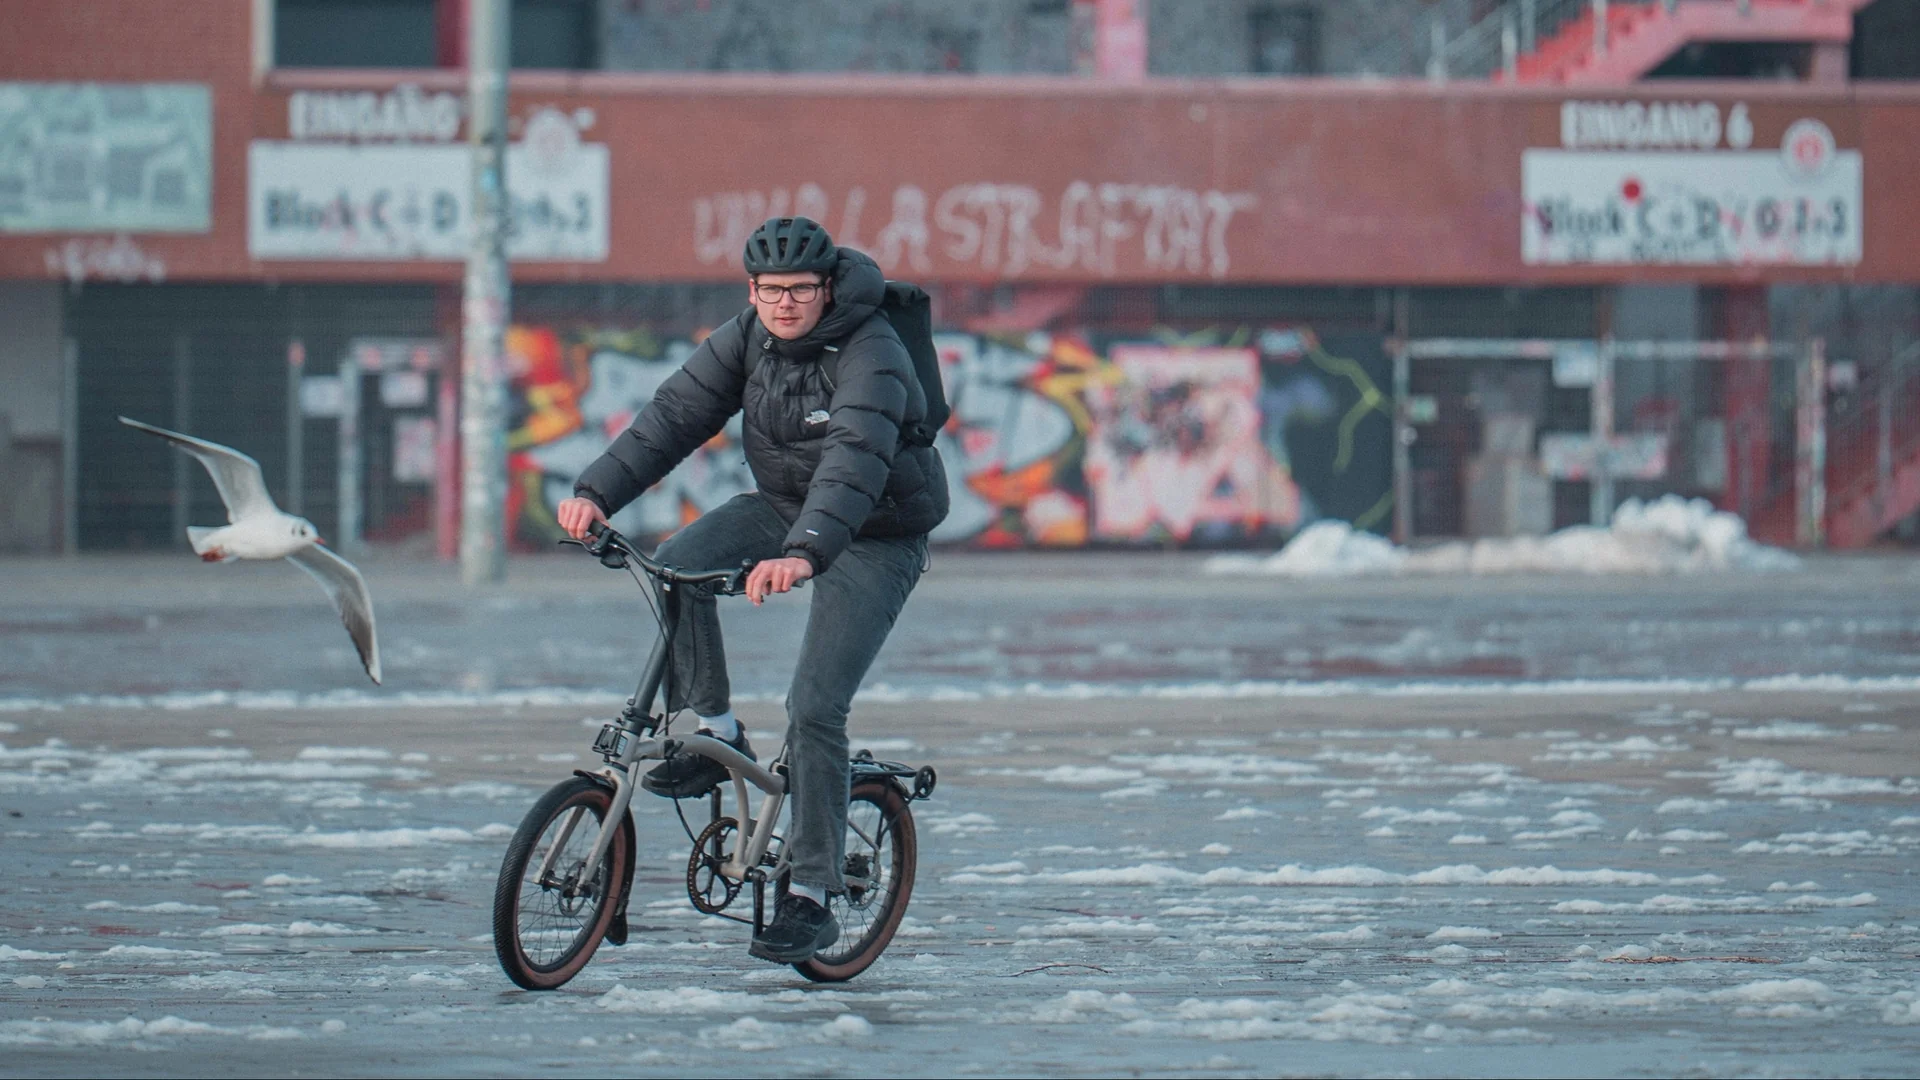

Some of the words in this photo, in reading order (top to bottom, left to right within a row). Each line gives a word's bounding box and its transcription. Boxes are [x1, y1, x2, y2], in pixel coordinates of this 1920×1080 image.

[289, 90, 461, 140] EINGANG
[1560, 100, 1721, 148] EINGANG
[1726, 100, 1753, 149] 6
[369, 188, 393, 231] C
[431, 190, 459, 232] D
